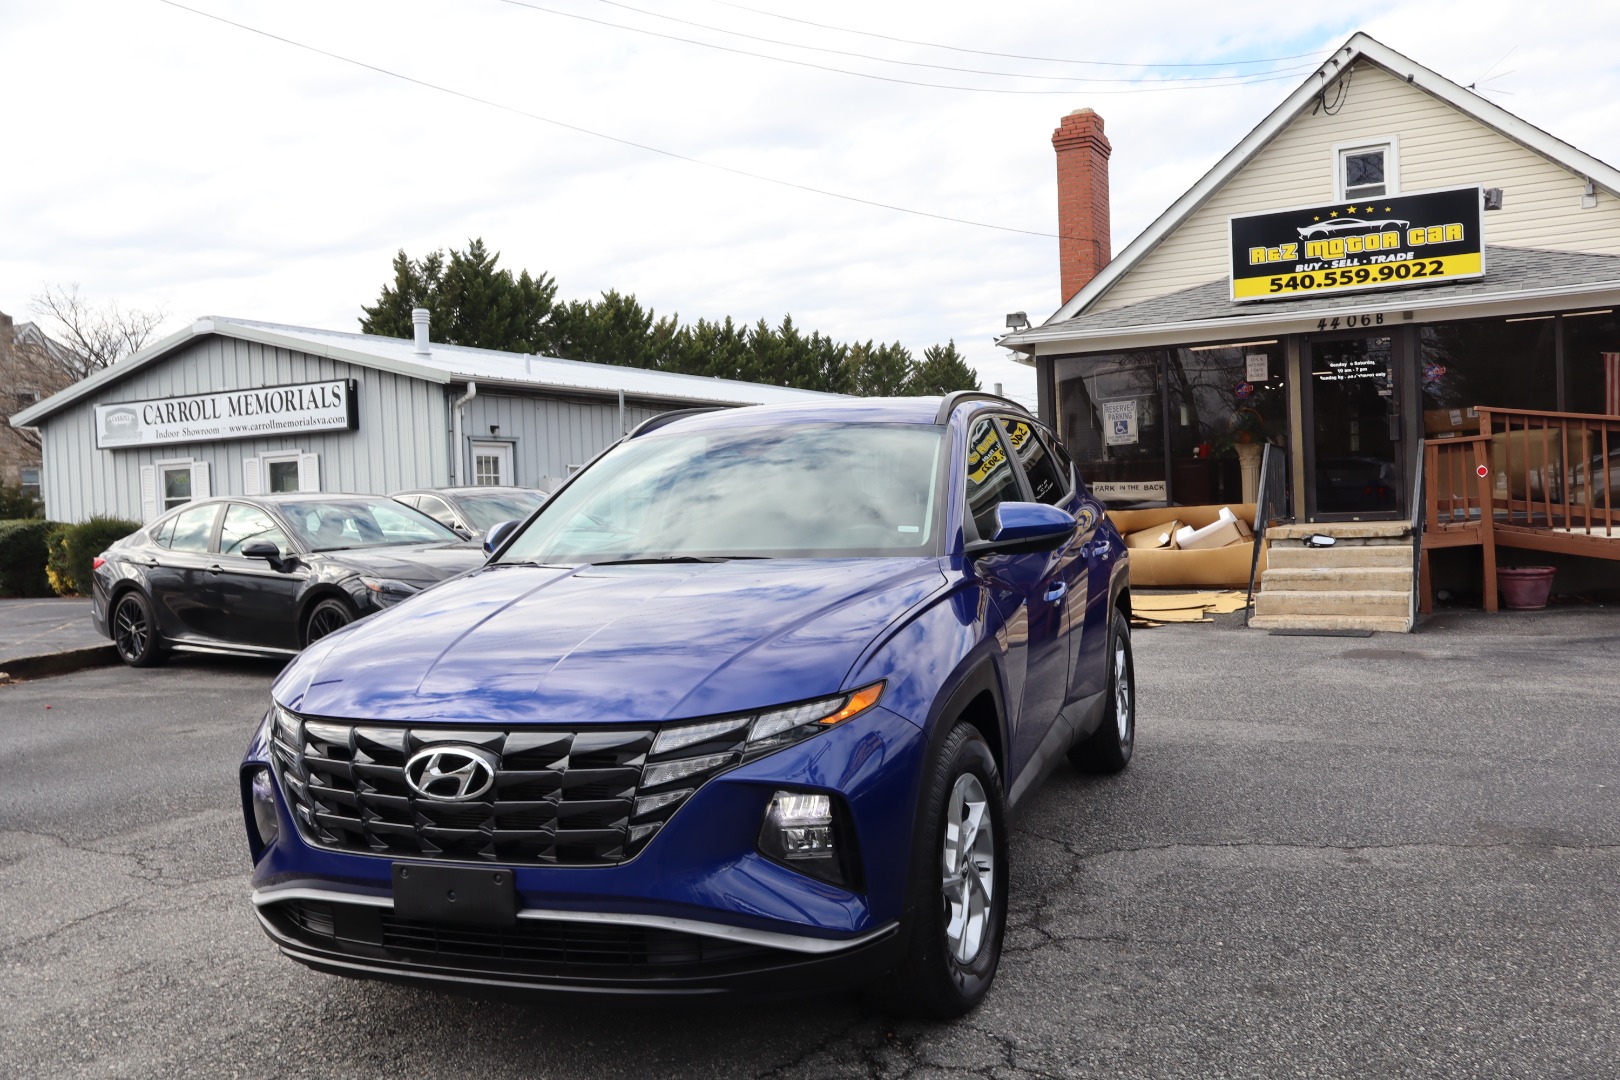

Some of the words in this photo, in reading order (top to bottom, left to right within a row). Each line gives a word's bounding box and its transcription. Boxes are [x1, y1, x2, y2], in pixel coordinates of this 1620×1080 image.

[1249, 242, 1299, 265] R&Z
[1295, 262, 1322, 272] BUY
[1331, 258, 1360, 269] SELL
[1370, 251, 1414, 264] TRADE
[1270, 260, 1444, 292] 540.559.9022
[143, 398, 221, 426] CARROLL
[227, 384, 342, 418] MEMORIALS
[1105, 403, 1134, 413] RESERVED
[1107, 412, 1133, 421] PARKING
[156, 429, 179, 439] Indoor
[182, 427, 220, 437] Showroom
[229, 415, 345, 432] www.carrollmemorialsva.com
